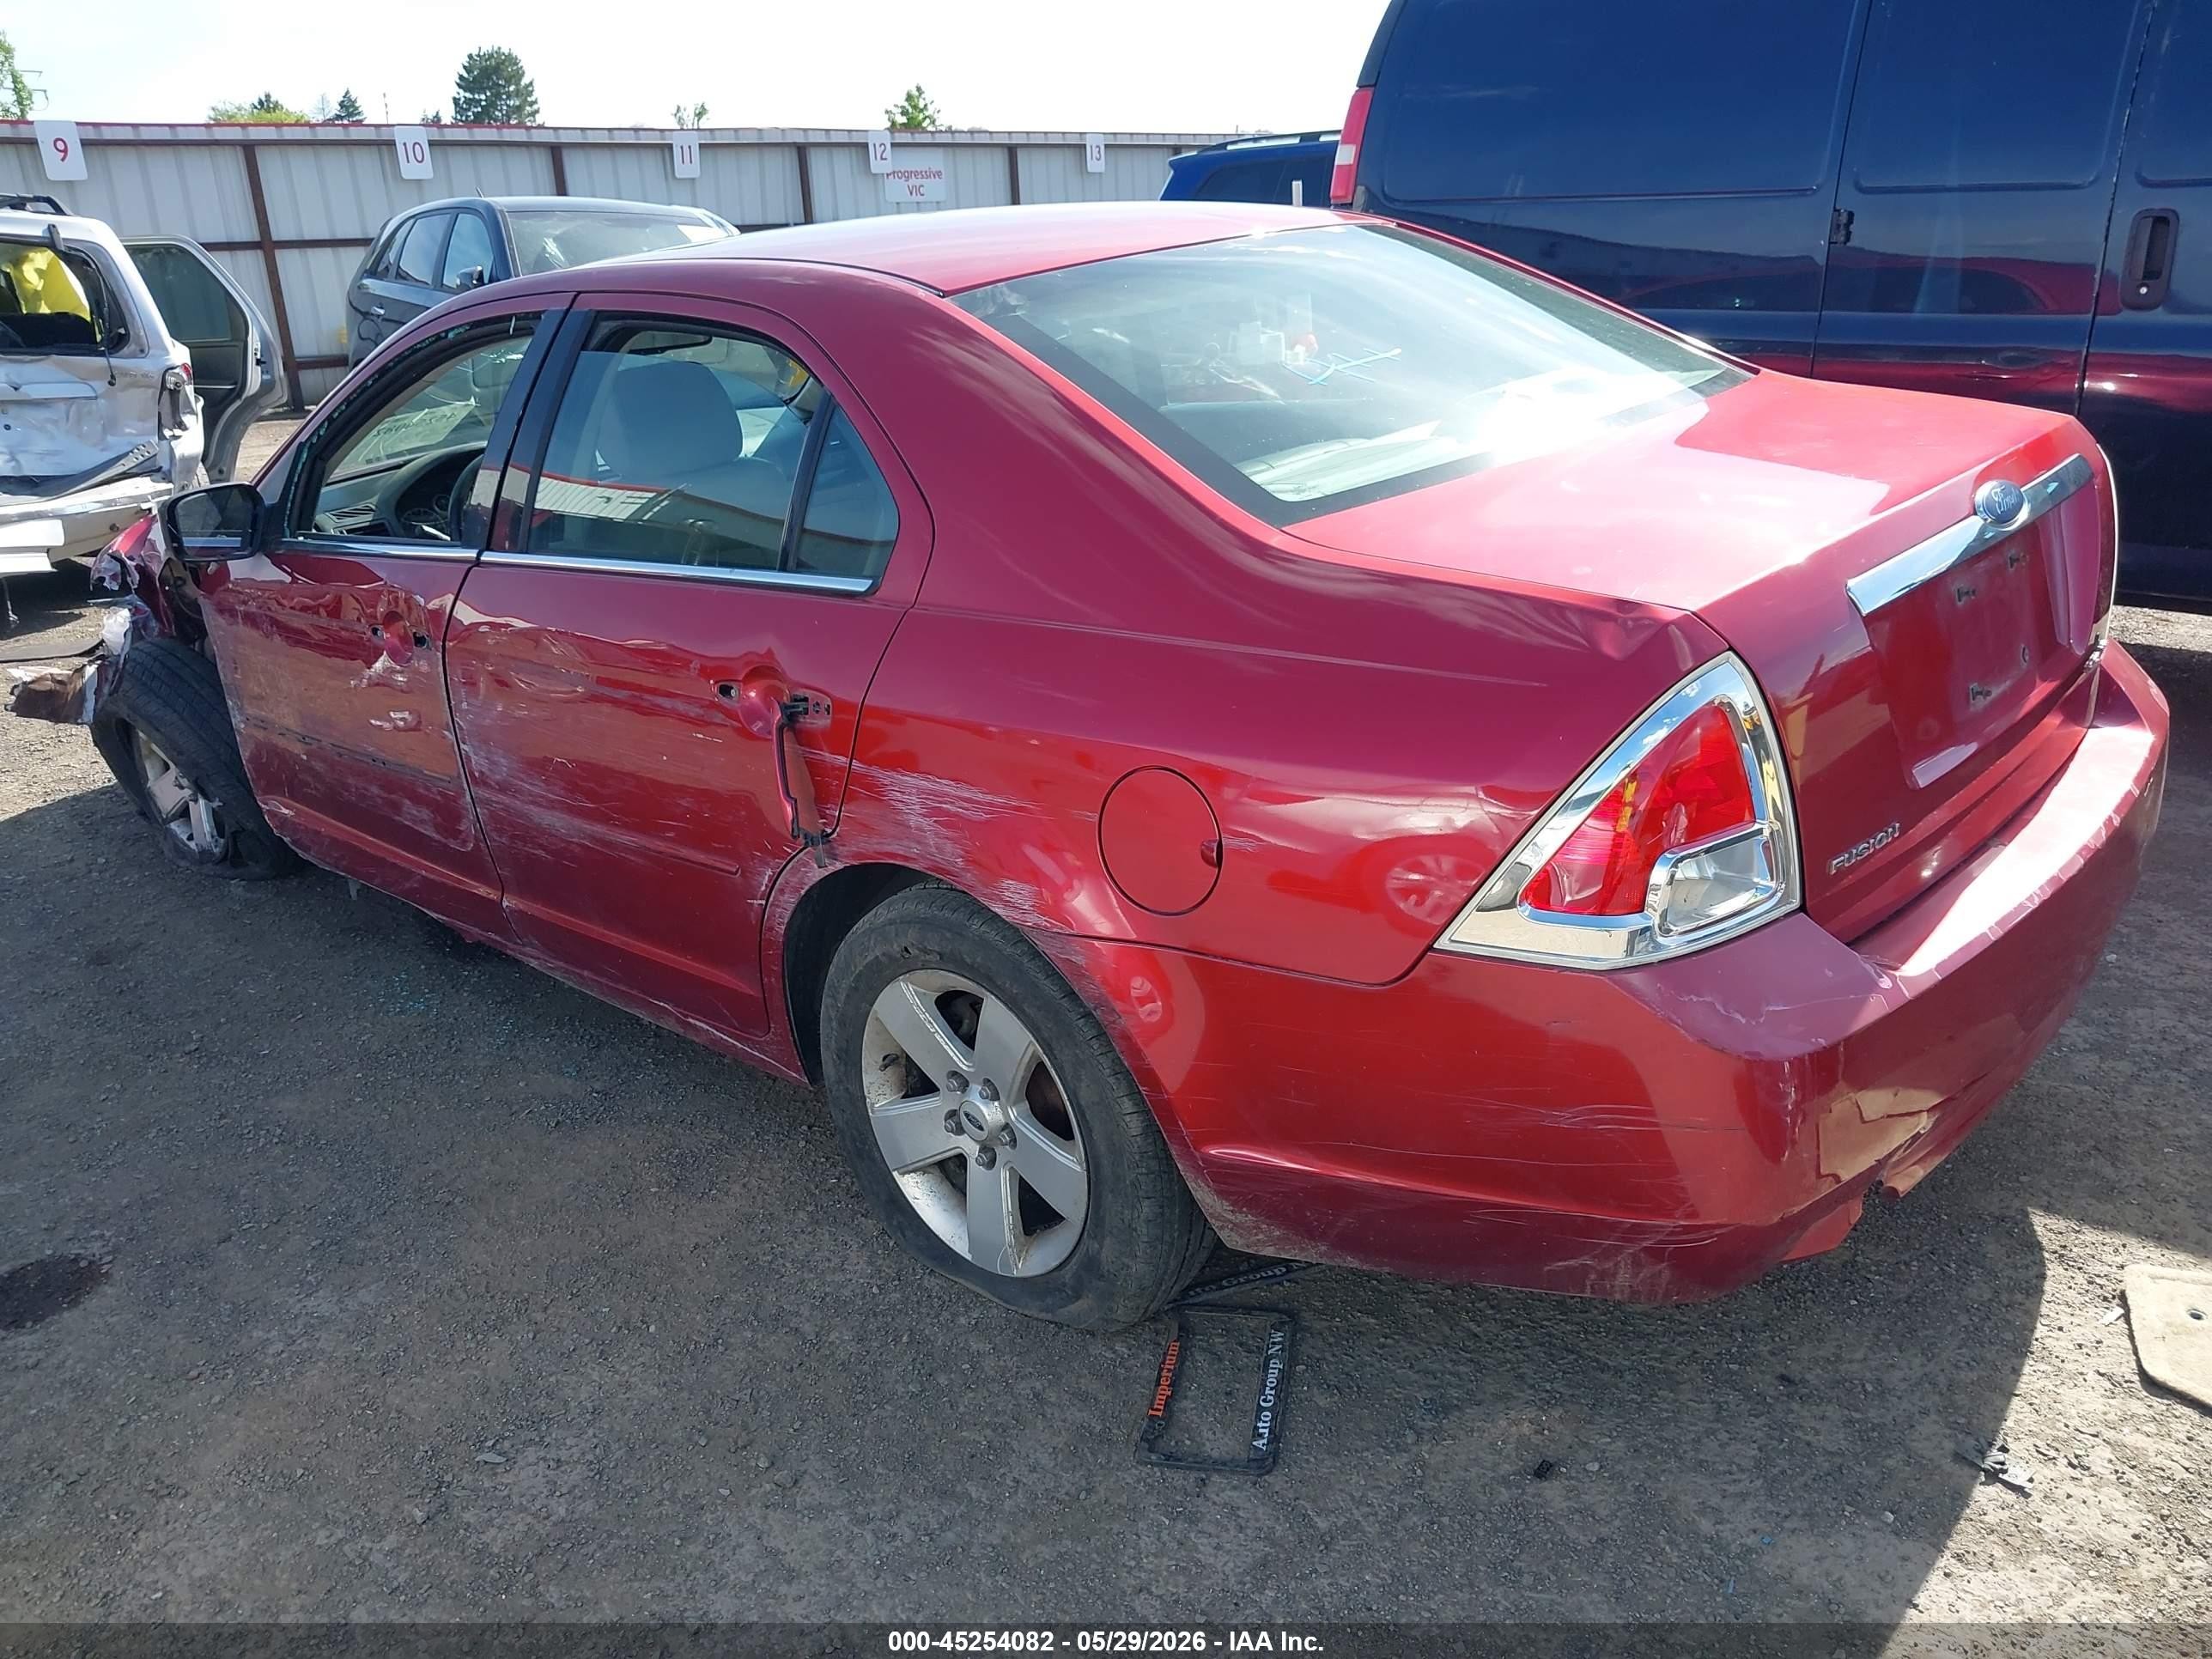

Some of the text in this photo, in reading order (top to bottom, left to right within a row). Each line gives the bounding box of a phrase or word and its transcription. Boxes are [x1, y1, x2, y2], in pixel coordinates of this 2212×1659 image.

[52, 137, 70, 162] 9
[402, 141, 426, 165] 10
[678, 141, 695, 166] 11
[872, 143, 888, 161] 12
[1088, 143, 1103, 161] 13
[886, 167, 943, 182] Progressive
[907, 185, 926, 198] VIC
[1827, 822, 1901, 876] FUSION
[1221, 1267, 1287, 1287] Group
[1267, 1328, 1286, 1356] NW
[1147, 1340, 1180, 1418] Imperium
[1259, 1358, 1283, 1408] Group
